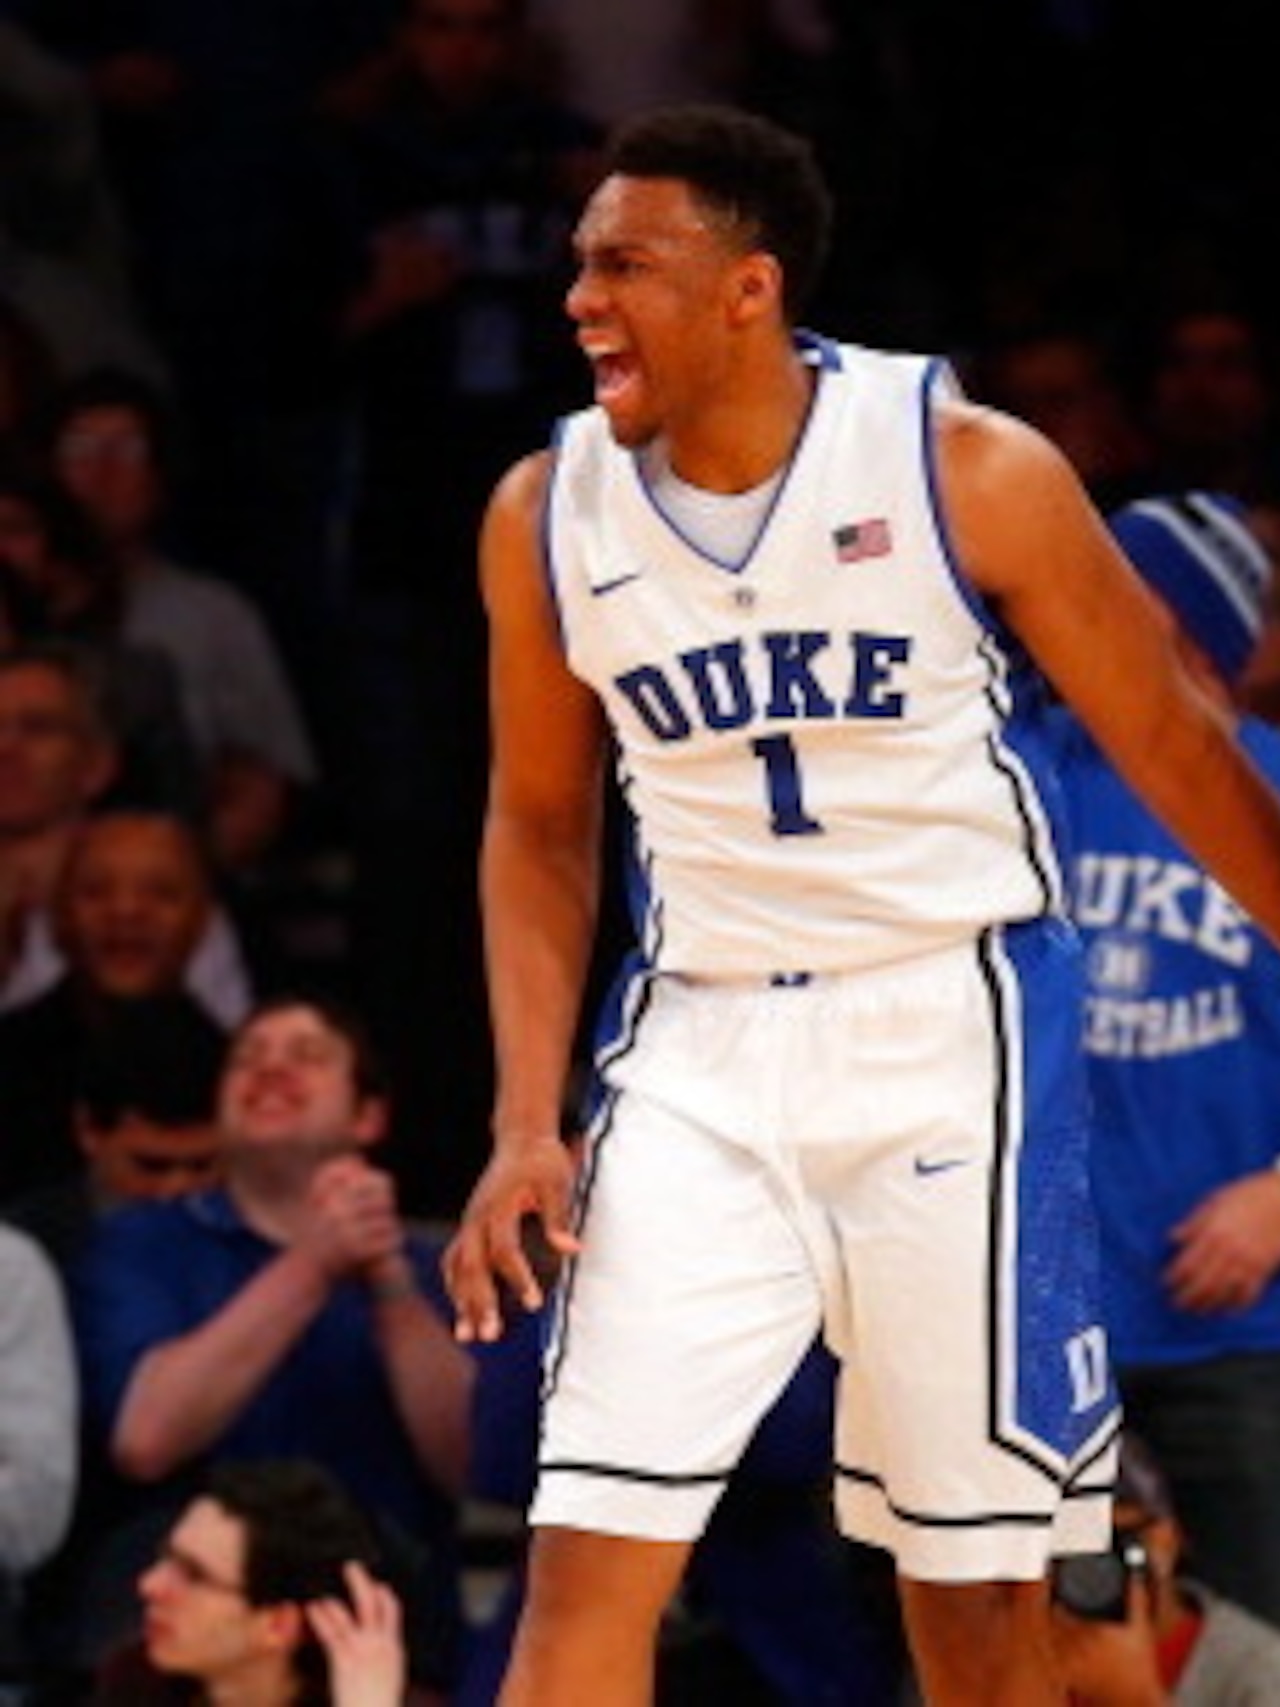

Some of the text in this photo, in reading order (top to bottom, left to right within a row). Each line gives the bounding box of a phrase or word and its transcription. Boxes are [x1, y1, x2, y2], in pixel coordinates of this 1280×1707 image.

[614, 630, 913, 743] DUKE
[749, 732, 824, 838] 1
[1066, 853, 1251, 968] UKE
[1083, 983, 1244, 1057] ETBALL
